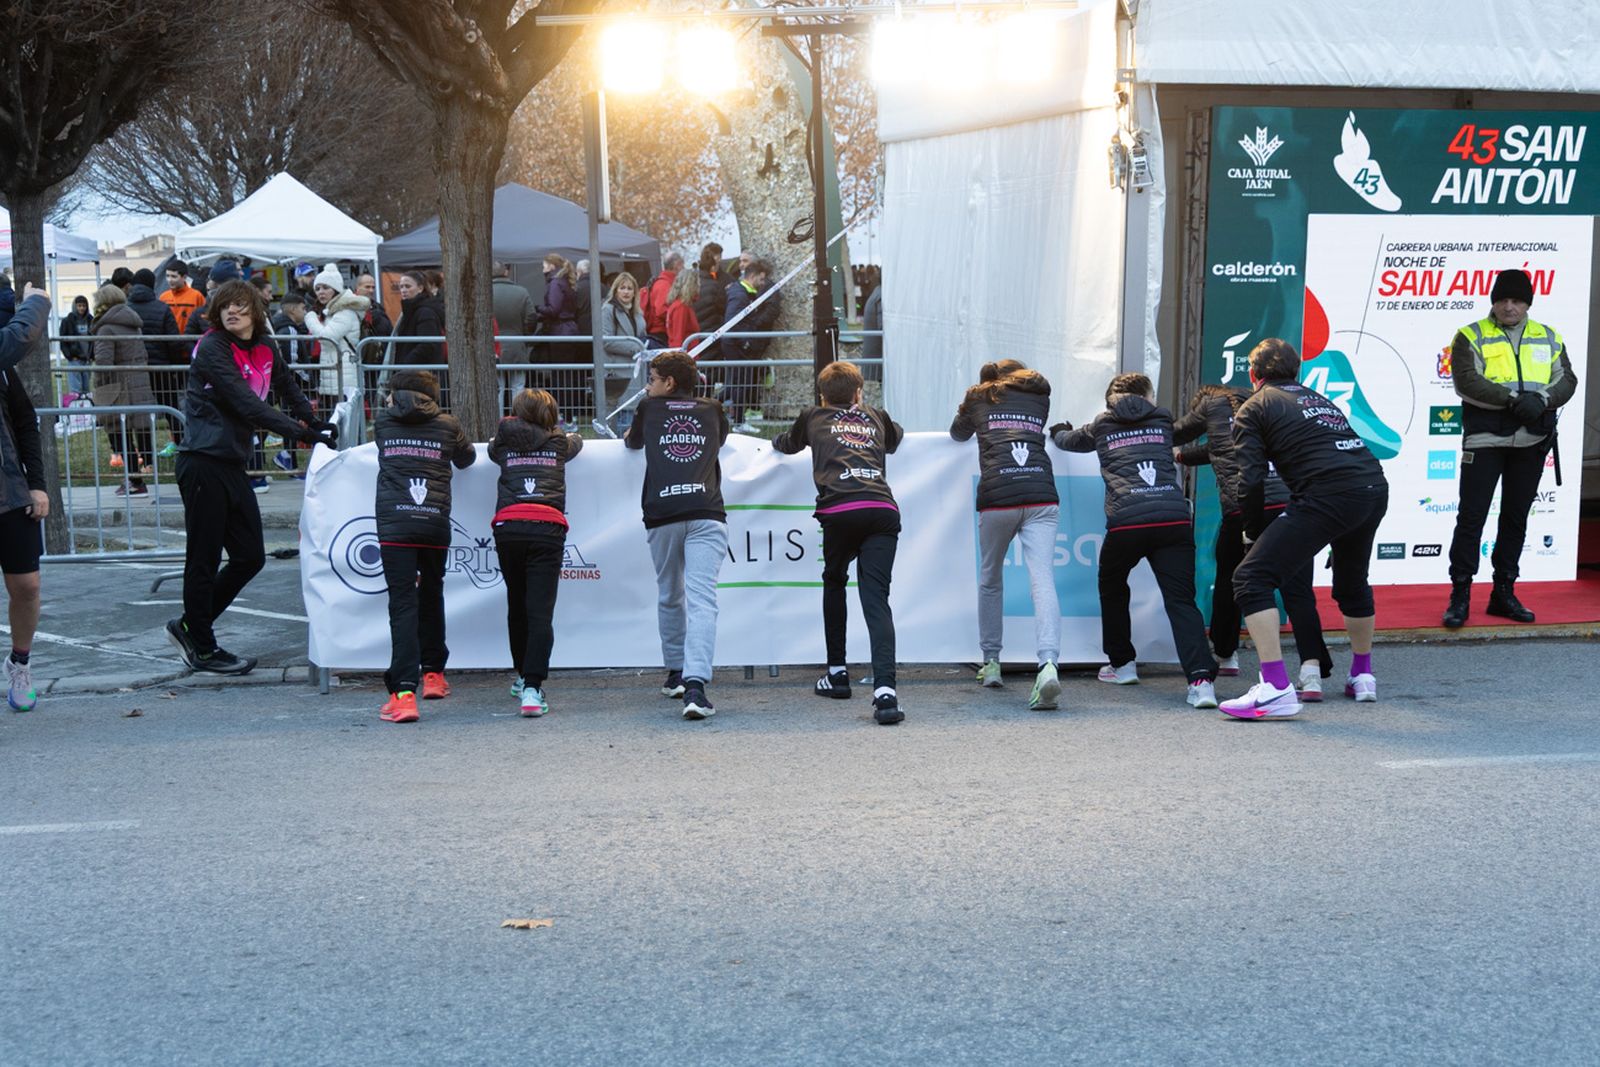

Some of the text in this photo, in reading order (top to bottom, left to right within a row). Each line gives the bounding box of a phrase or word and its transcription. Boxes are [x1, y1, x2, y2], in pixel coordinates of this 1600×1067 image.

[1228, 168, 1292, 179] CAJA RURAL
[1353, 168, 1381, 195] 43
[1431, 157, 1576, 205] ANTÓN
[1386, 243, 1558, 252] CARRERA URBANA INTERNACIONAL
[1384, 257, 1447, 268] NOCHE DE
[1212, 261, 1297, 276] calderón
[1378, 270, 1444, 297] SAN
[1376, 301, 1474, 310] 17 DE ENERO DE 2026
[831, 424, 876, 436] ACADEMY
[1106, 429, 1143, 441] ATLETISMO
[659, 434, 706, 445] ACADEMY
[1425, 501, 1459, 516] aquali
[1414, 547, 1440, 555] 42K
[559, 569, 601, 580] ISCINAS
